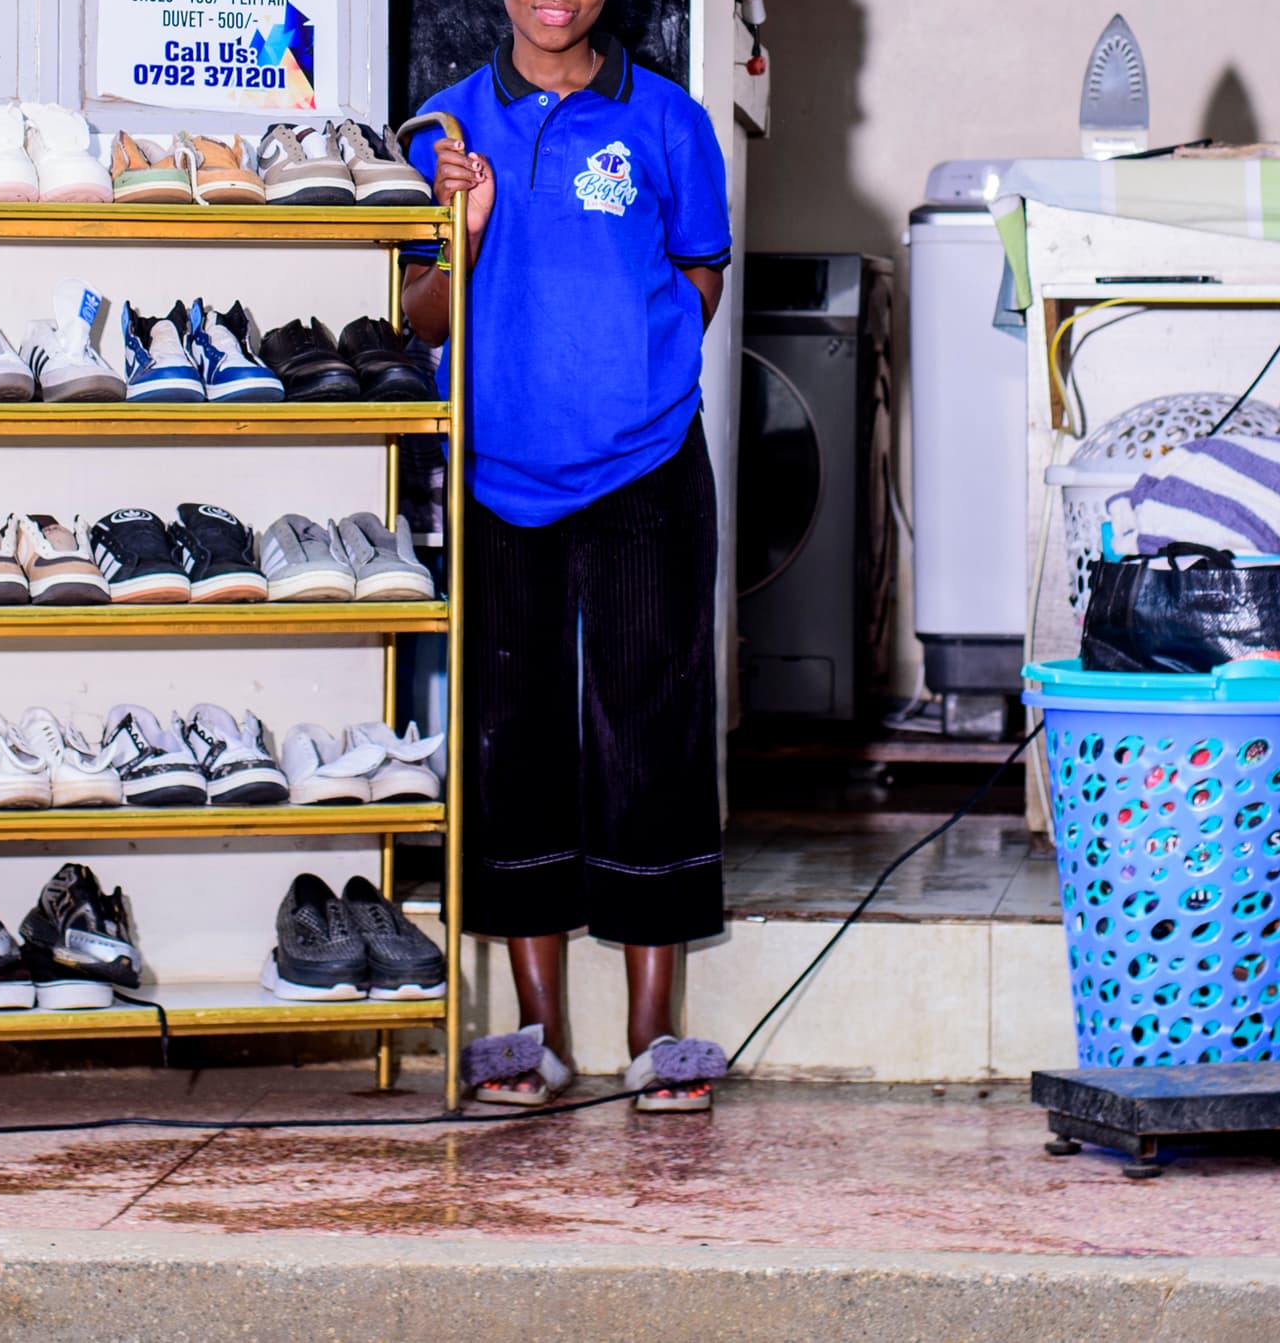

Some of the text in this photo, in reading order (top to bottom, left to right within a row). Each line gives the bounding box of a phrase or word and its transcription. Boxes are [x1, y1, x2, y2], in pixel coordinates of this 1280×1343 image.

[163, 10, 205, 28] DUVET
[218, 12, 259, 29] 500/-
[165, 40, 256, 64] Call Us:
[134, 64, 286, 88] 0792 371201
